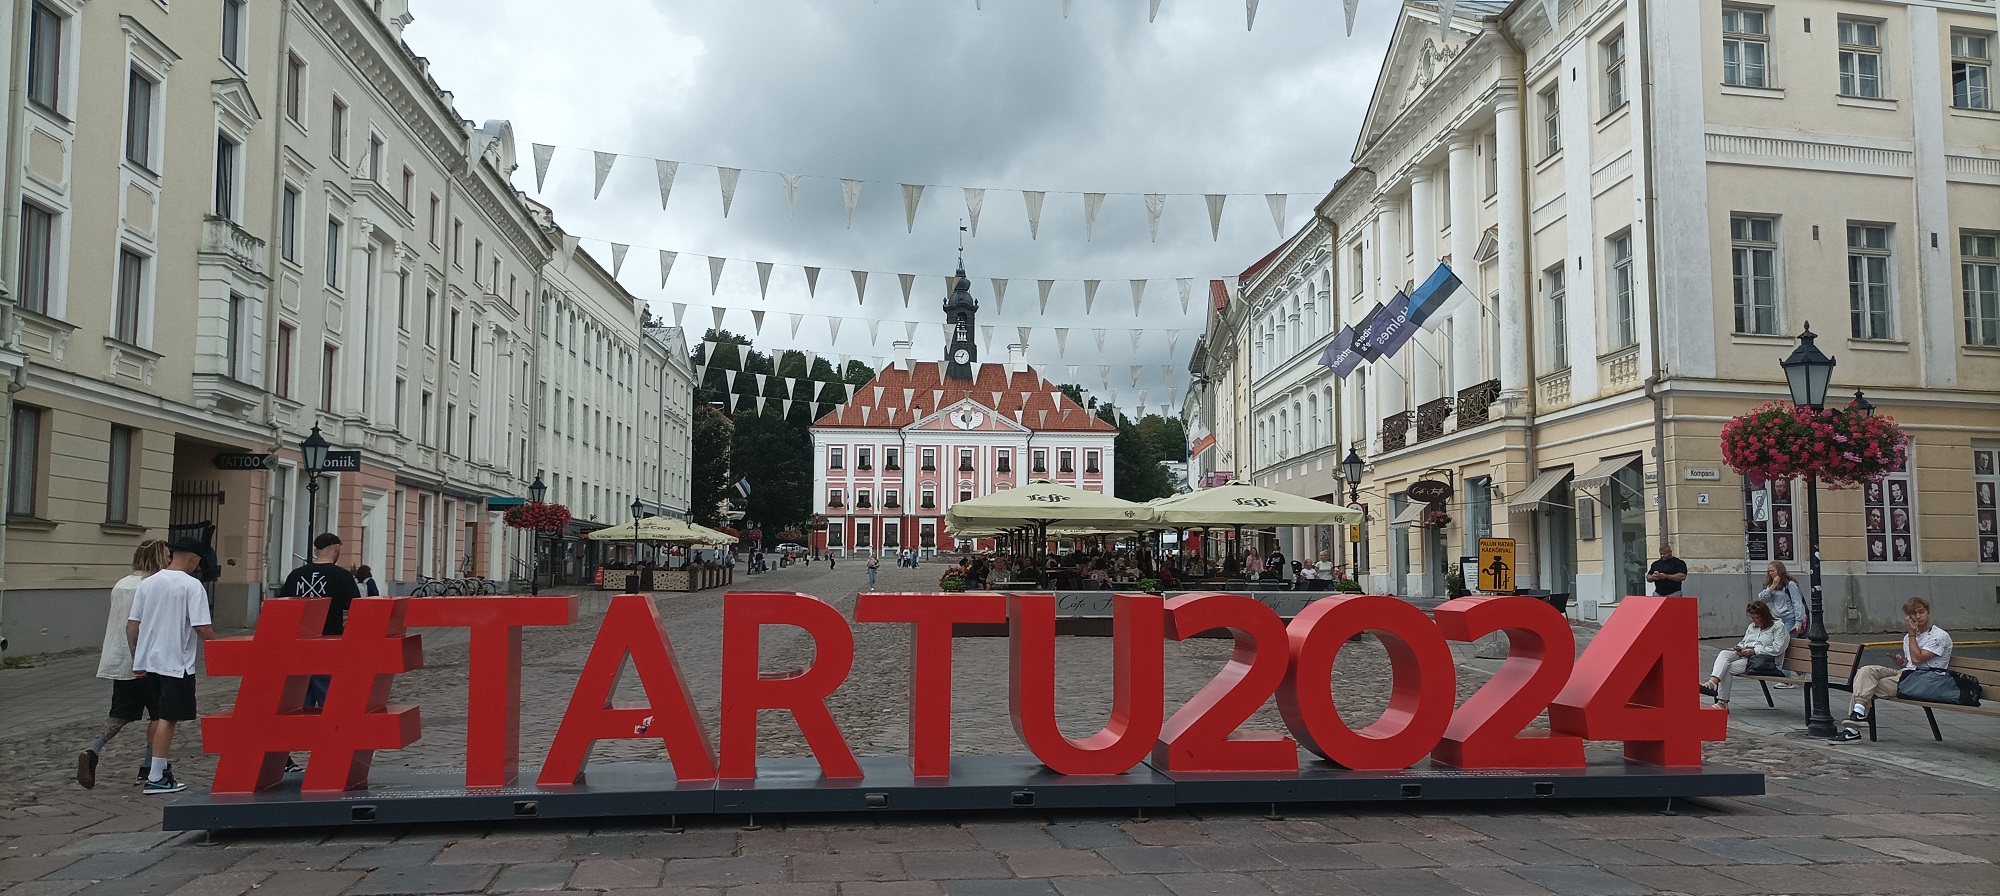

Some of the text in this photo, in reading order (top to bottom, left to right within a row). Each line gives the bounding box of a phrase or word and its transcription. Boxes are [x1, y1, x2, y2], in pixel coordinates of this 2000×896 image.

[220, 456, 260, 467] TATTOO
[322, 455, 355, 467] oniik
[1700, 494, 1706, 503] 2
[200, 591, 1728, 795] #TARTU2024
